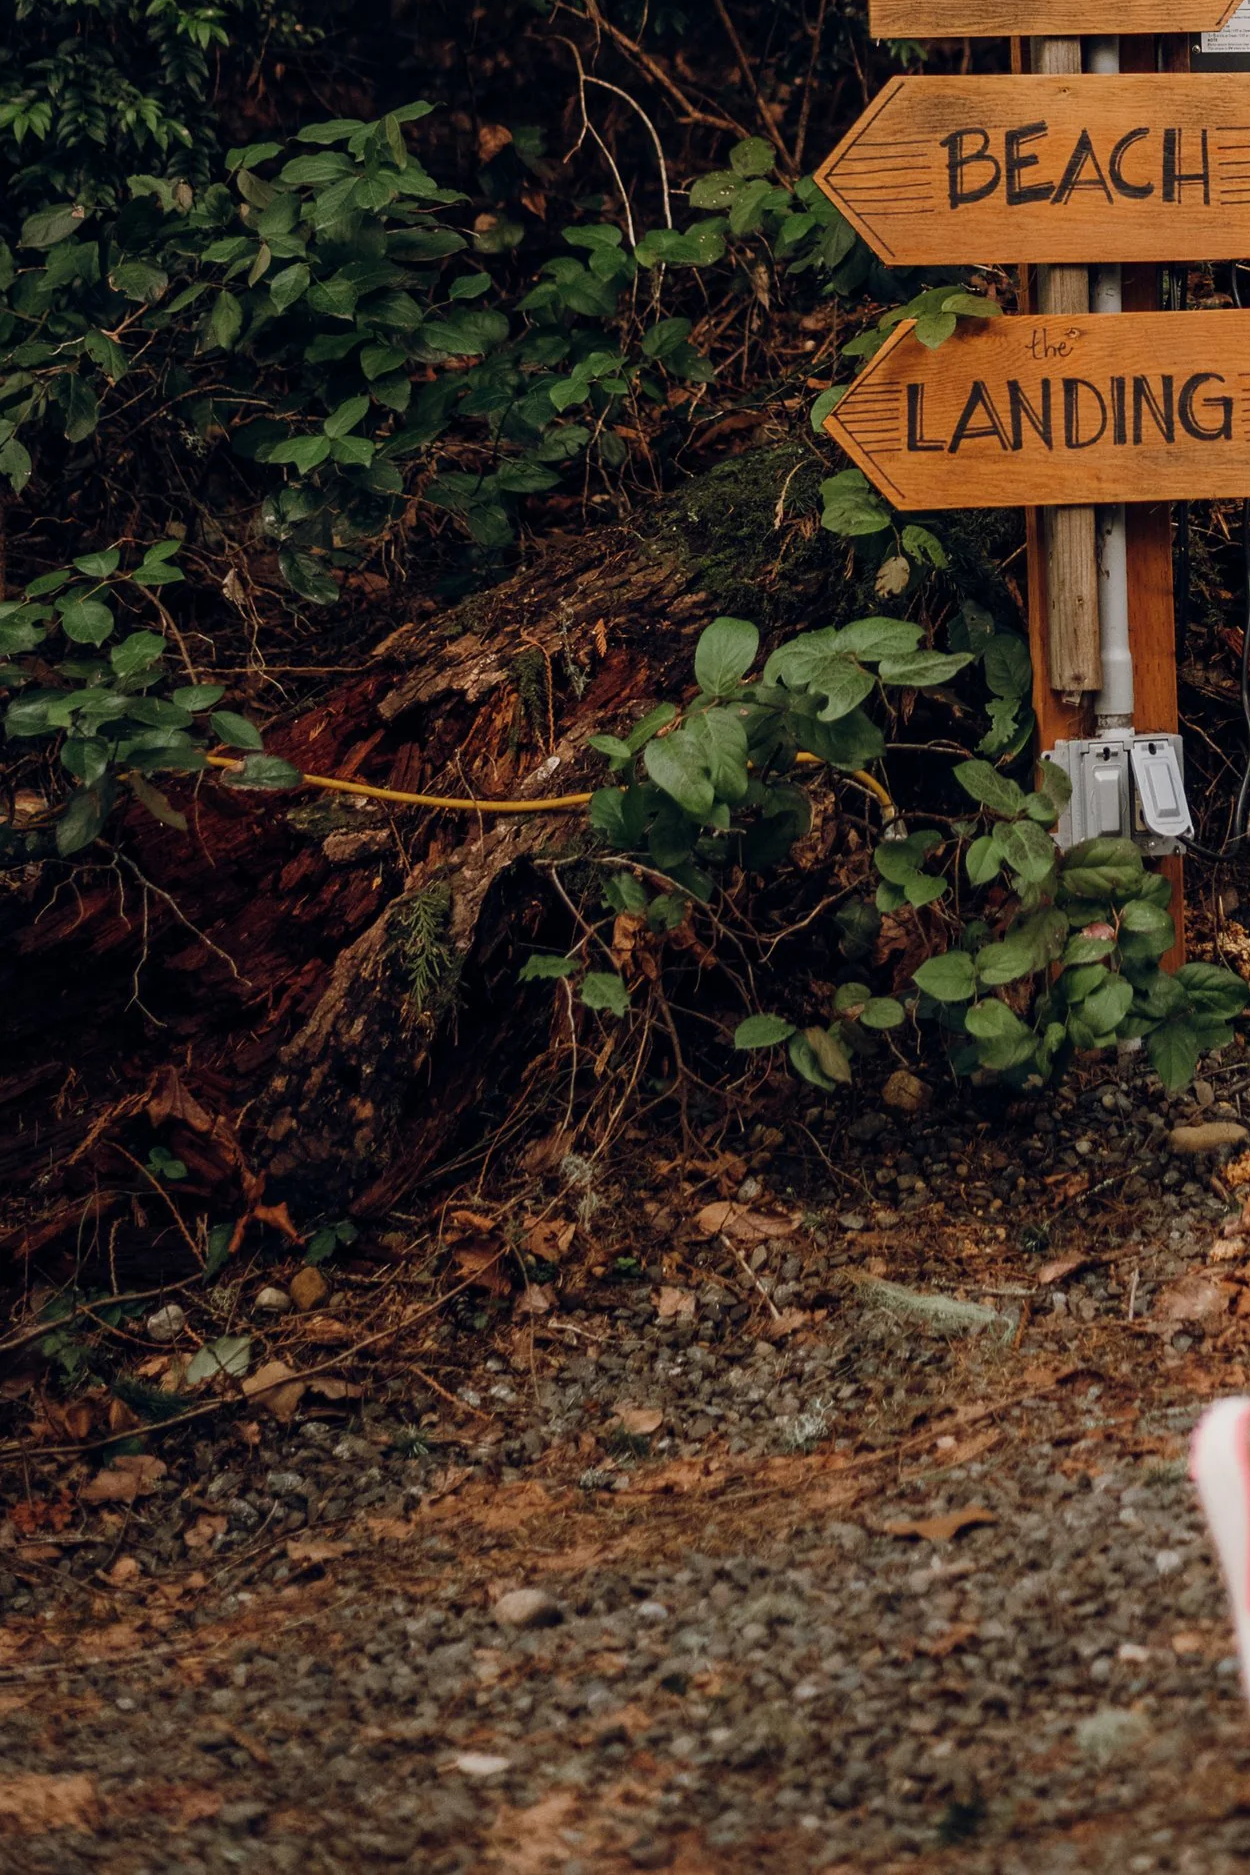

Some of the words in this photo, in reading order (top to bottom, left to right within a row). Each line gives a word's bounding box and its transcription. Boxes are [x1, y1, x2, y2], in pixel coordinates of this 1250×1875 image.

[939, 119, 1211, 210] BEACH
[1025, 328, 1074, 360] the
[906, 372, 1233, 454] LANDING
